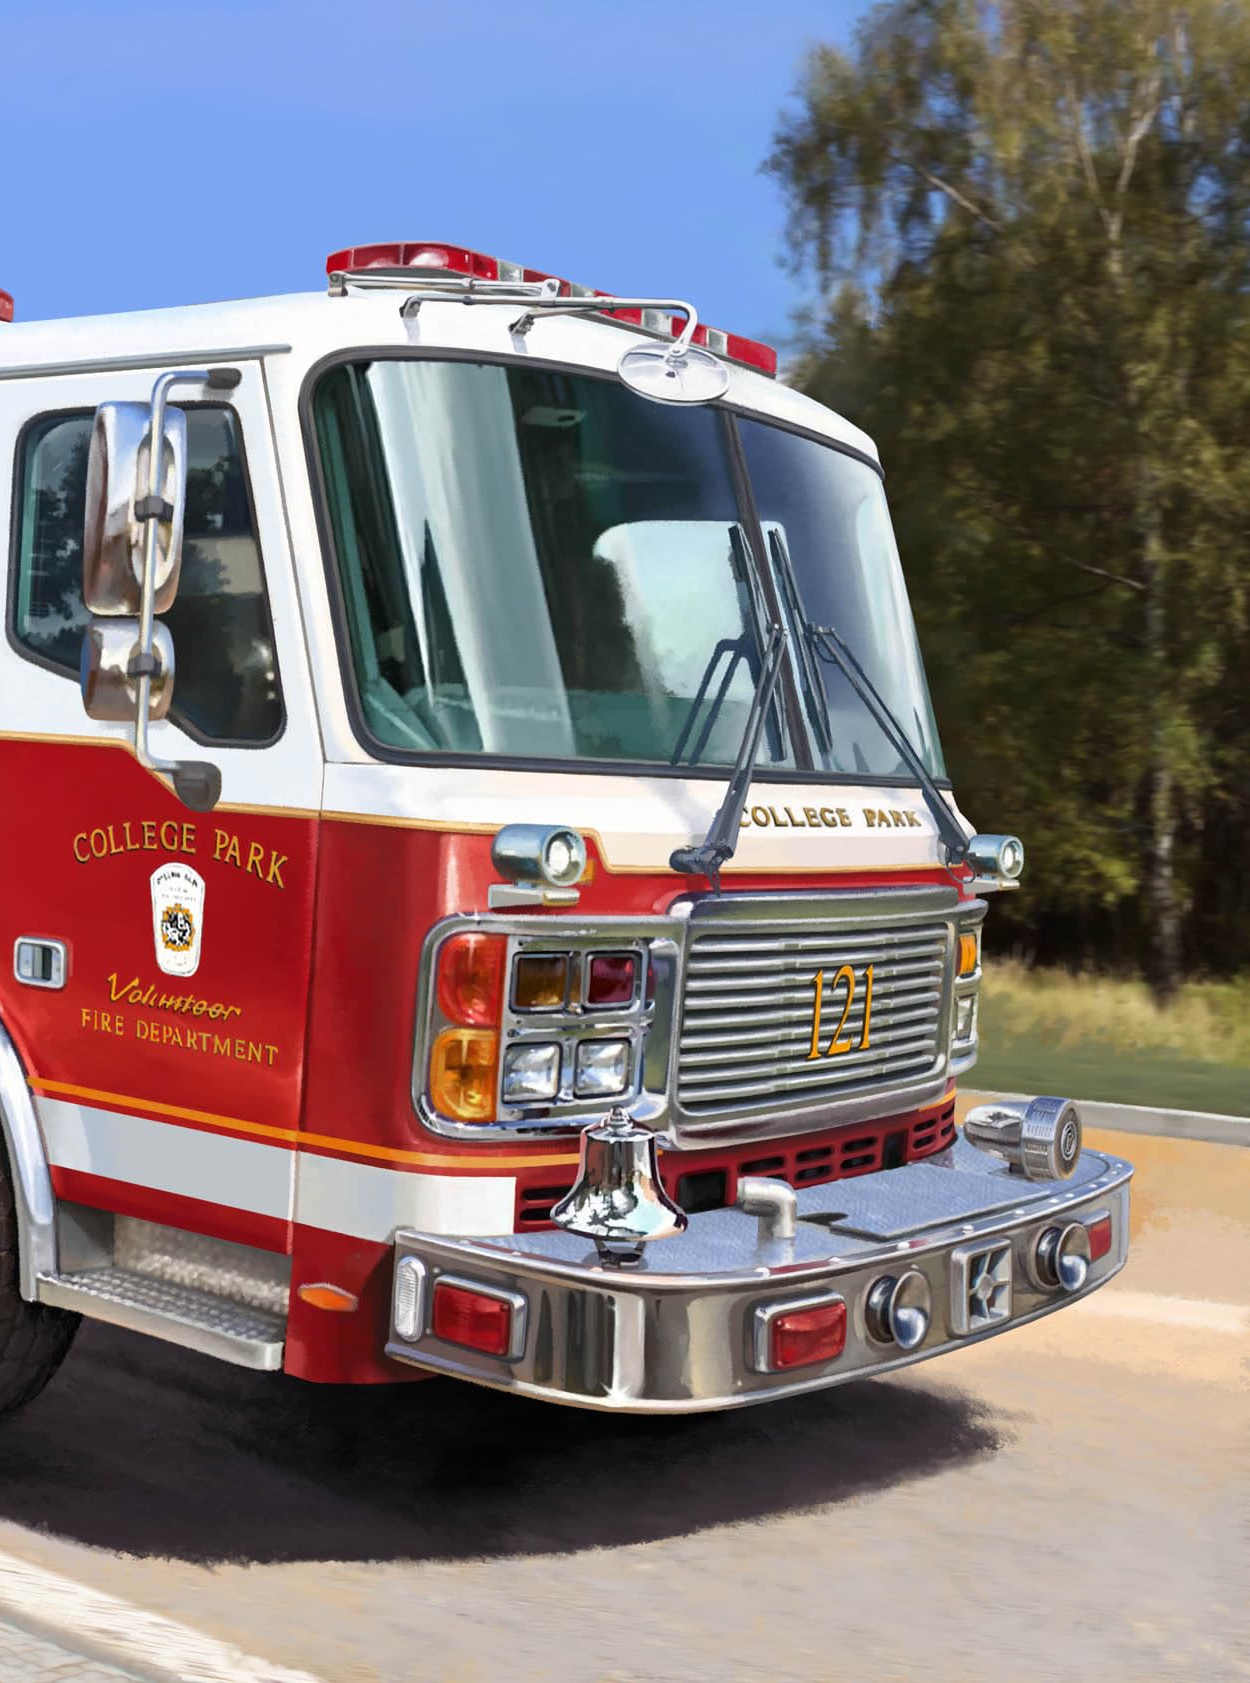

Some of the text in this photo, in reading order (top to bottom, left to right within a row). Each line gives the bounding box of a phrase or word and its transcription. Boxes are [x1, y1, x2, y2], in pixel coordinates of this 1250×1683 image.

[862, 808, 922, 828] PARK
[73, 820, 288, 889] COLLEGE PARK
[81, 1008, 278, 1066] FIRE DEPARTMENT
[806, 963, 875, 1061] 121
